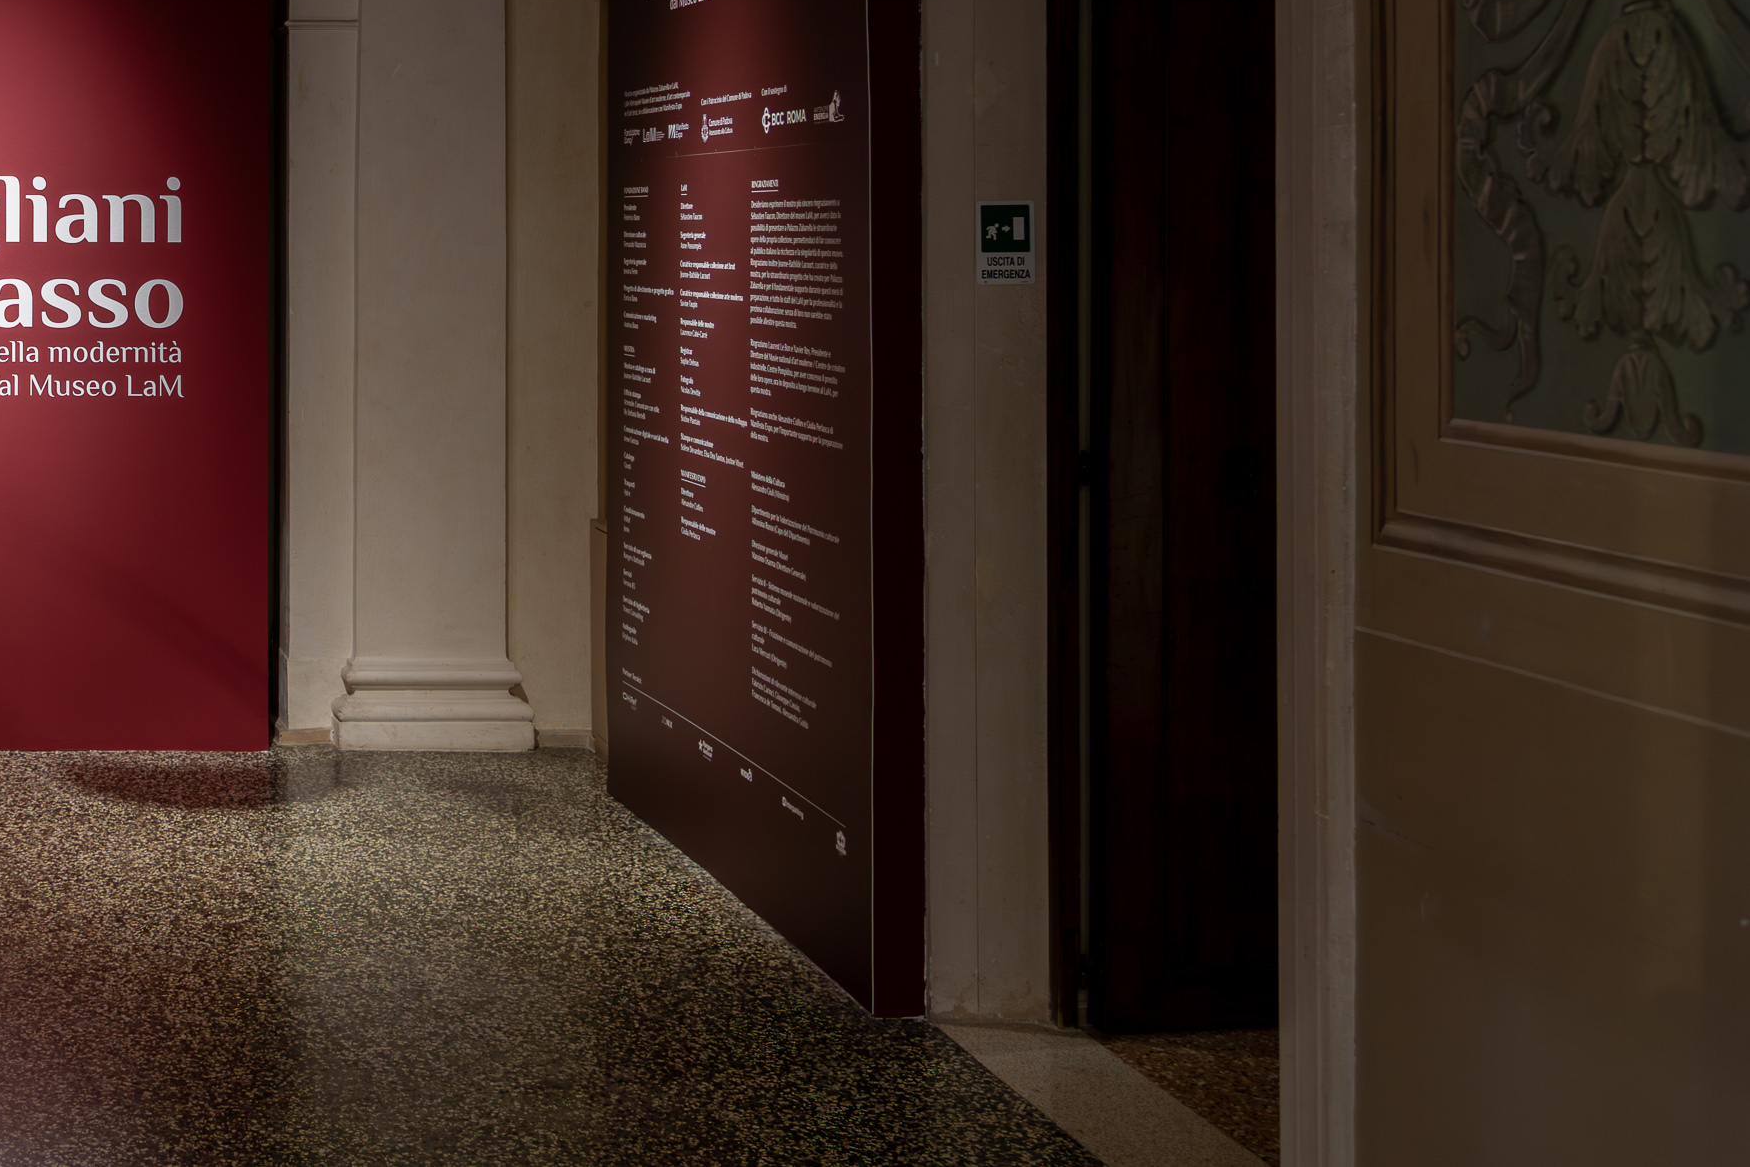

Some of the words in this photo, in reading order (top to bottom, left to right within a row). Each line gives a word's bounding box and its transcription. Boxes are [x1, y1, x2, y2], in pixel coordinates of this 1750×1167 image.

[772, 112, 785, 126] BCC
[786, 109, 806, 124] ROMA
[987, 257, 1014, 266] USCITA
[1017, 257, 1024, 266] DI
[982, 270, 1030, 279] EMERGENZA
[48, 340, 182, 363] modernità
[29, 374, 116, 397] Museo
[126, 374, 183, 398] LaM
